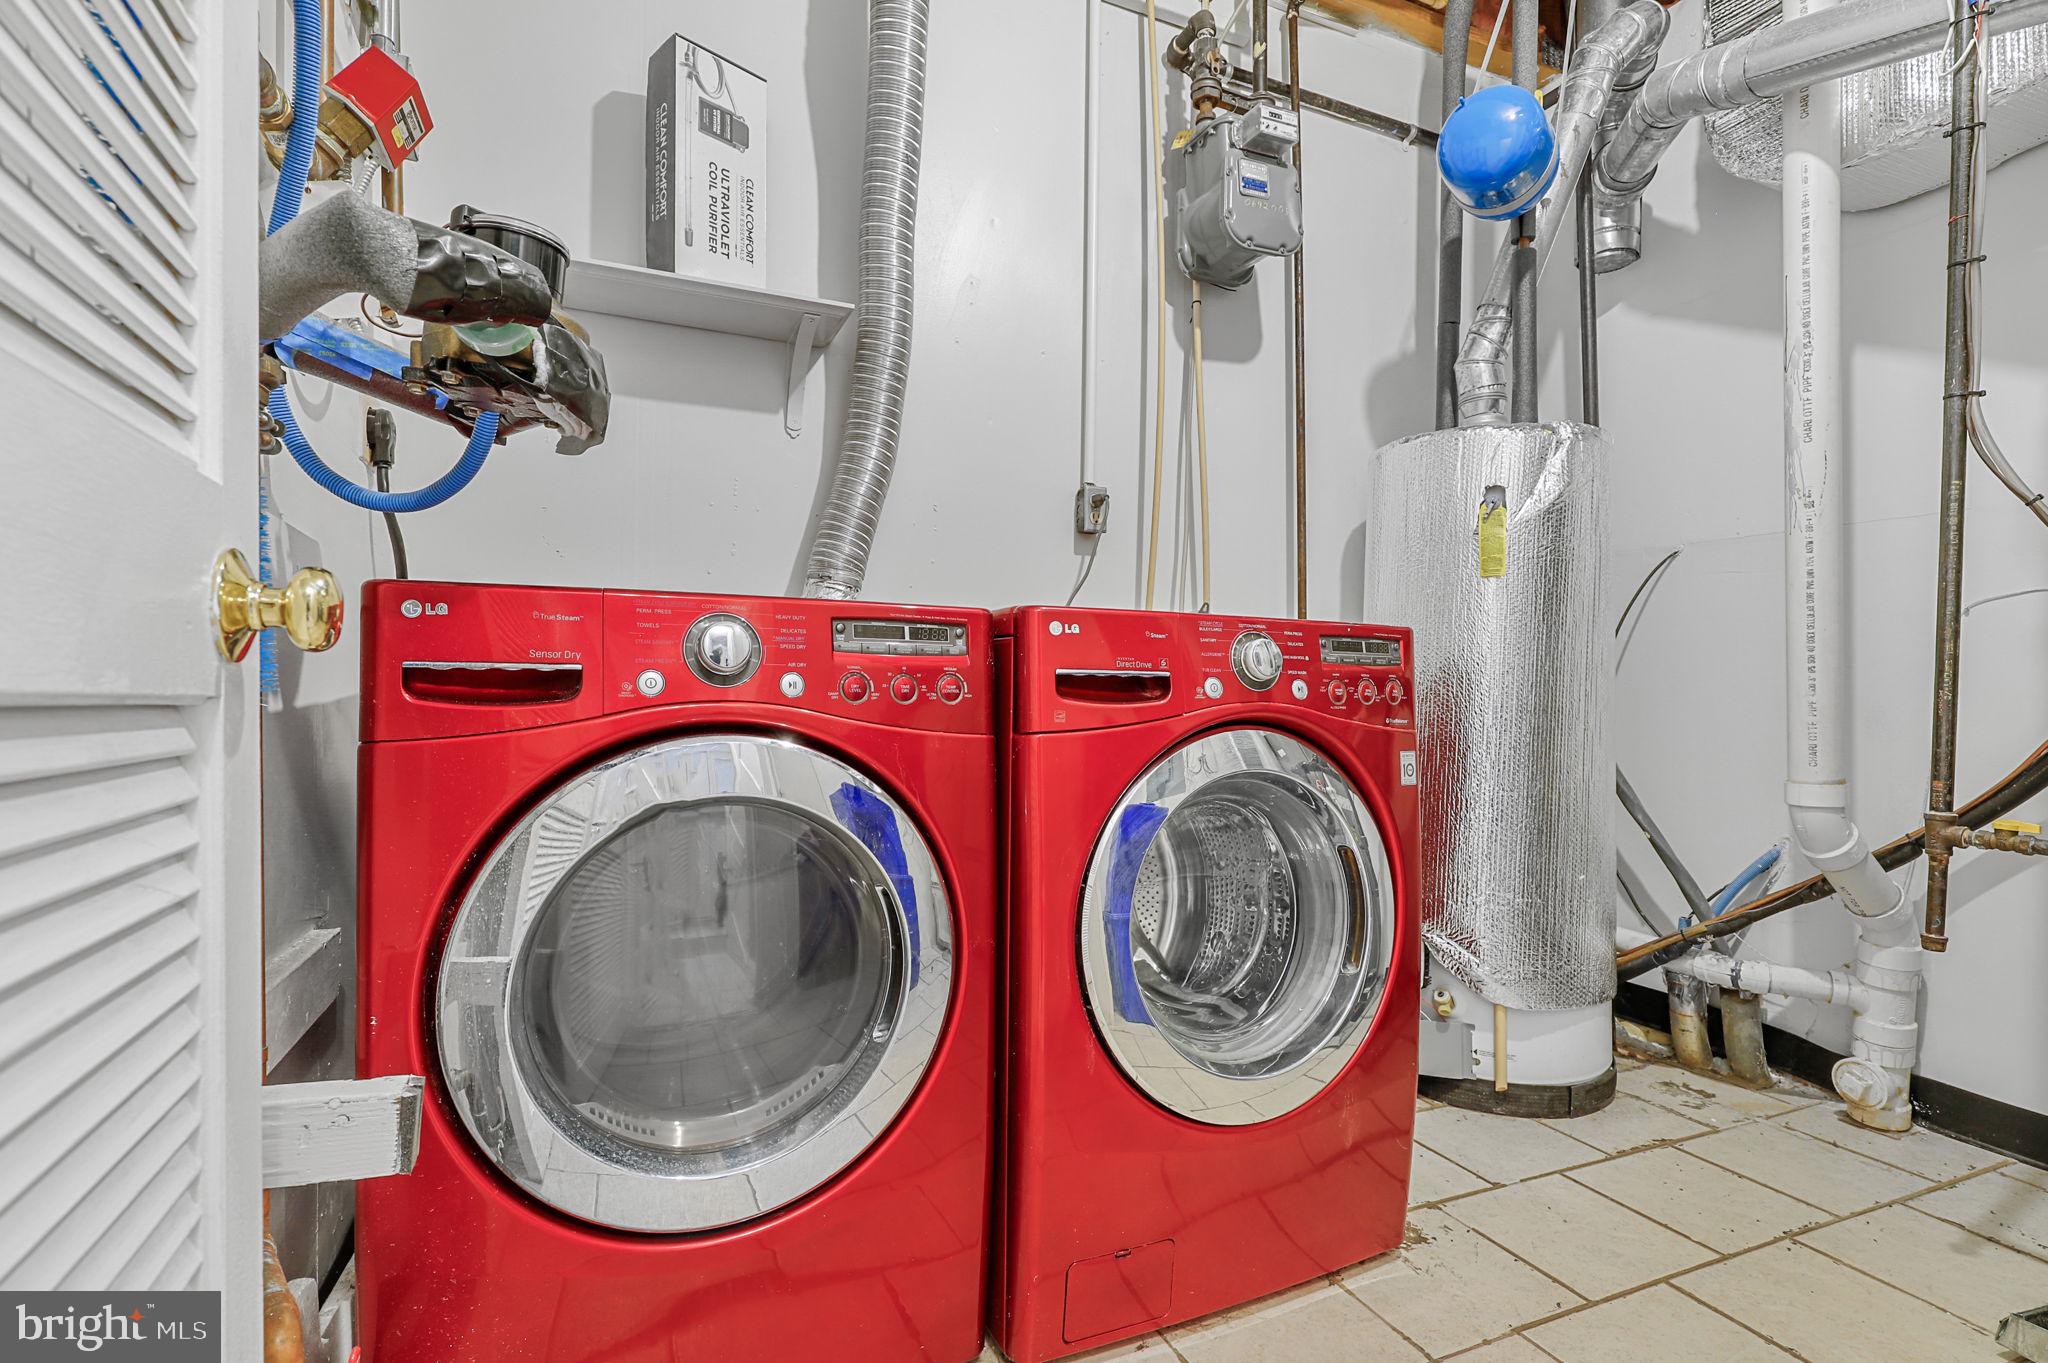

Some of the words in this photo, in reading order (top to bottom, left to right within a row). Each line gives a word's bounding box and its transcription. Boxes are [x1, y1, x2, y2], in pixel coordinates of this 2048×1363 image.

[659, 102, 668, 148] CLEAN
[658, 149, 668, 217] COMFORT
[708, 161, 718, 191] COIL
[745, 178, 754, 213] CLEAN
[708, 195, 718, 254] PURIFIER
[720, 168, 731, 259] ULTRAVIOLET
[745, 213, 755, 264] COMFORT
[1064, 624, 1080, 634] LG
[529, 650, 562, 659] Sensor
[564, 650, 582, 660] Dry
